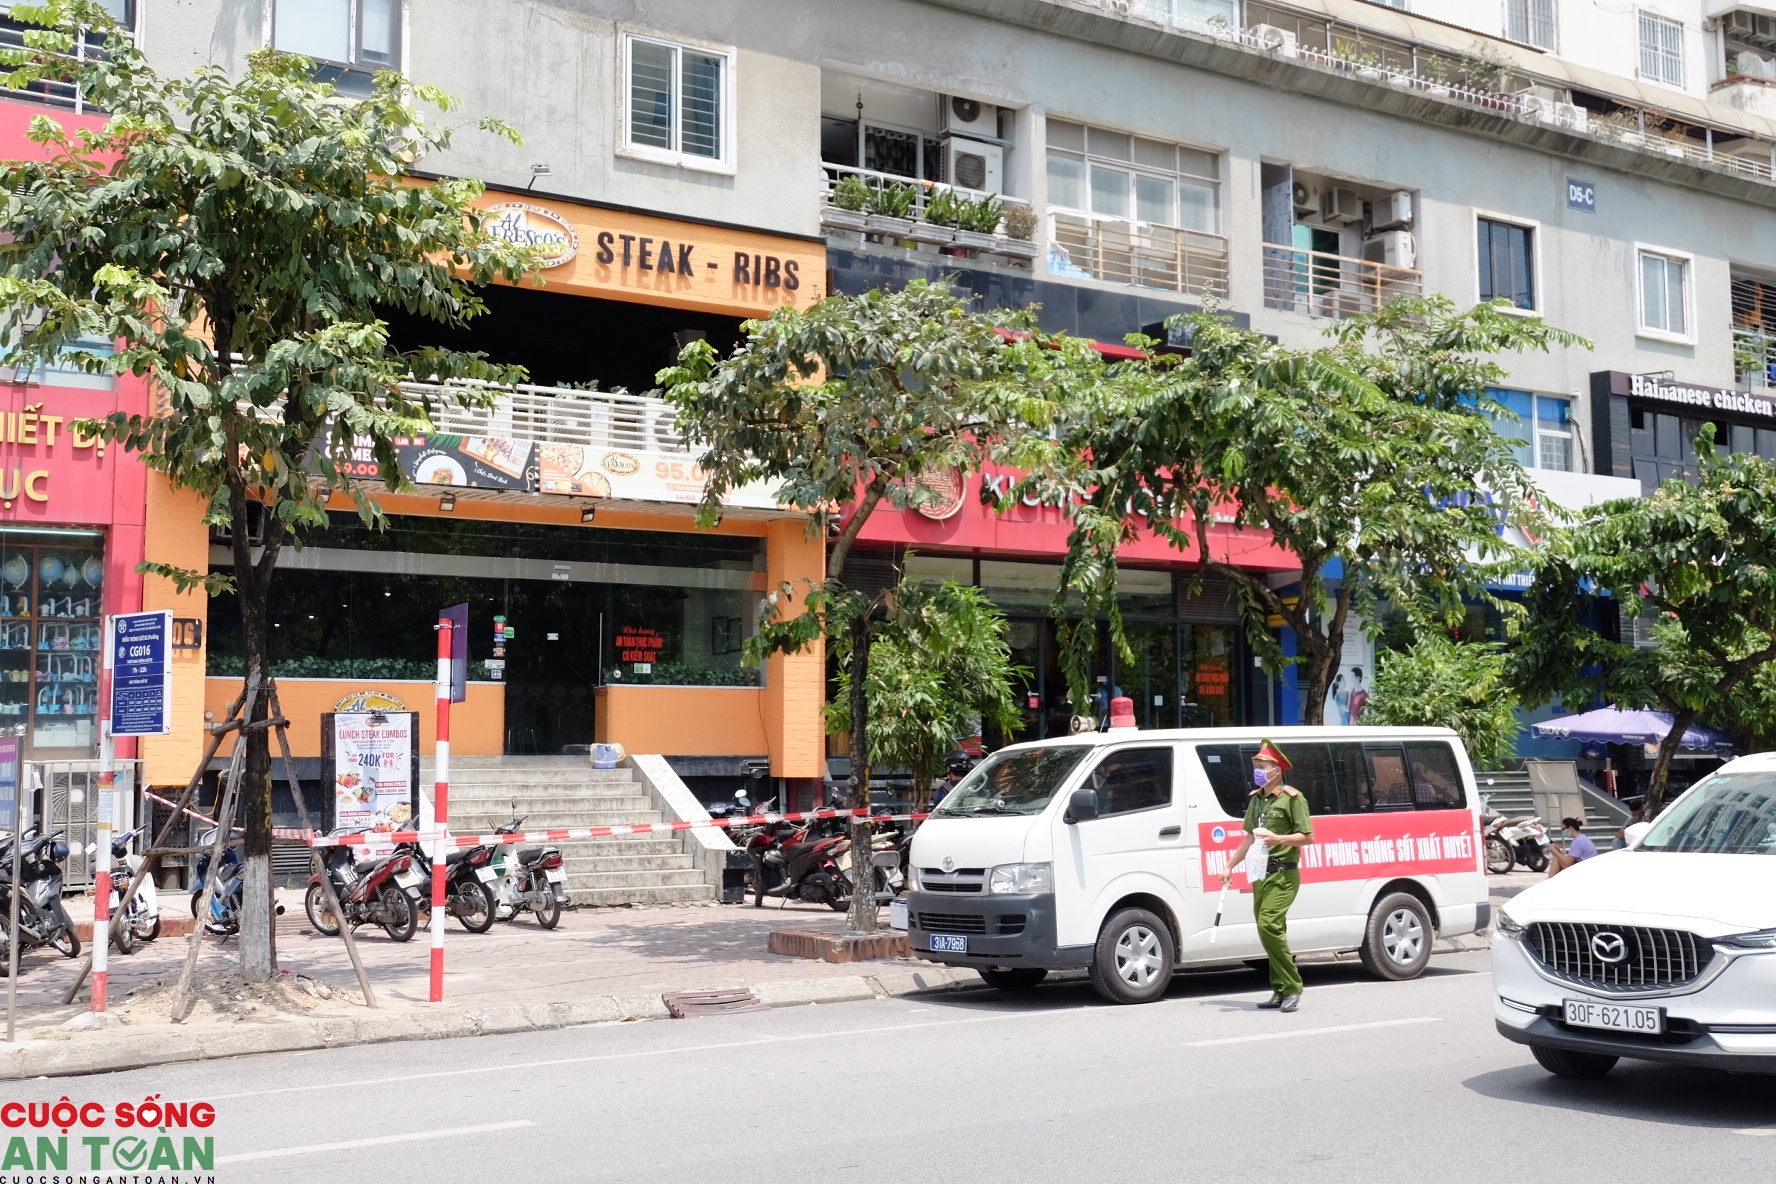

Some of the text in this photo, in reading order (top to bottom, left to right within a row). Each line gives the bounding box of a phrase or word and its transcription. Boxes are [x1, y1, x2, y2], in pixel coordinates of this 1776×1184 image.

[1569, 184, 1593, 205] D5-C
[500, 212, 522, 231] Al
[596, 230, 694, 277] STEAK
[734, 251, 800, 291] RIBS
[1630, 374, 1774, 416] Hainanese chicken
[129, 644, 151, 657] CG016
[339, 729, 408, 740] LUNCH STEAK COMBOS
[1538, 725, 1562, 736] BIDV
[358, 753, 381, 768] 240K
[1303, 843, 1323, 868] TAY
[1324, 838, 1360, 867] PHÒNG
[1360, 835, 1396, 864] CHỐNG
[1396, 833, 1415, 862] SỐT
[1416, 832, 1441, 860] XUẤT
[1442, 830, 1472, 859] HUYẾT
[1568, 1003, 1656, 1030] 30F-621.05
